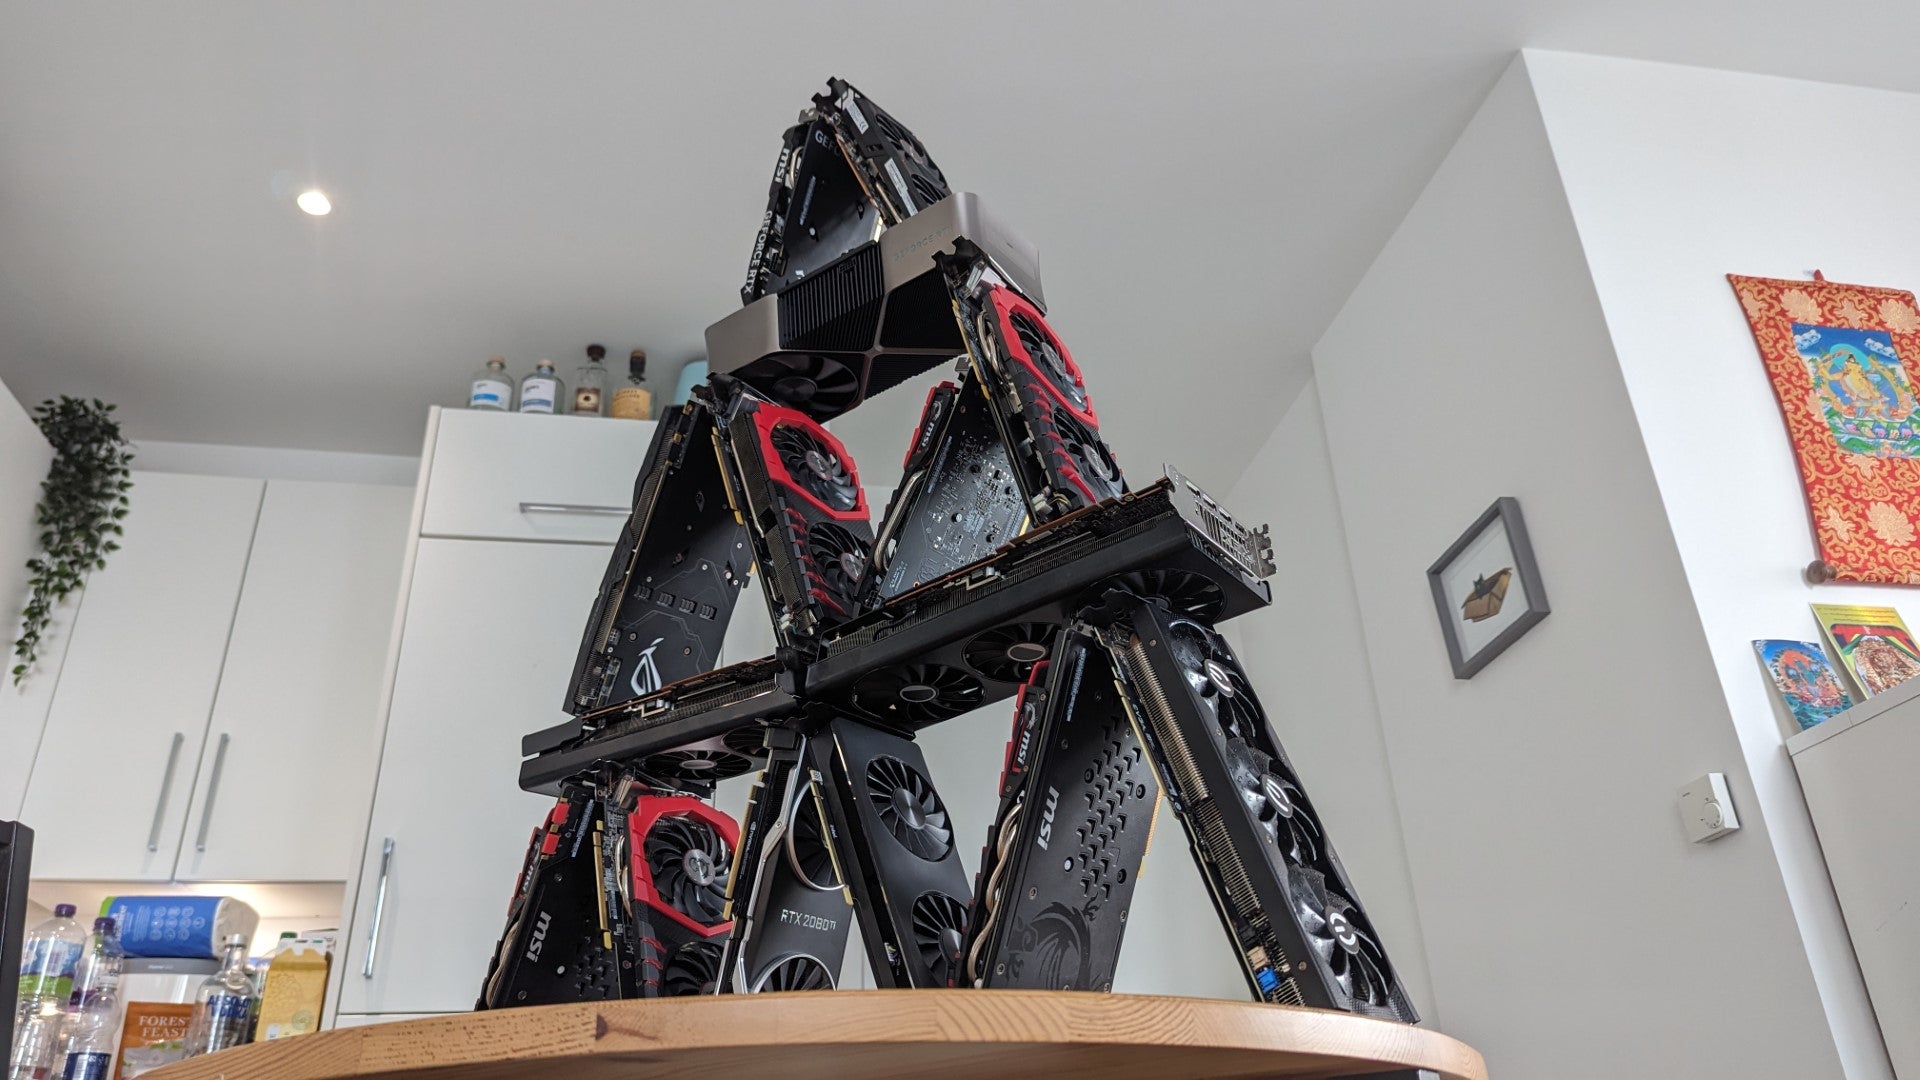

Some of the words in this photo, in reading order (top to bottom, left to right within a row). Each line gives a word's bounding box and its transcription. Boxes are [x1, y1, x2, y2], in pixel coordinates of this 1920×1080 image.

[750, 210, 773, 267] GEFORCE
[743, 269, 758, 294] RTX
[1017, 731, 1031, 765] msi
[1037, 785, 1060, 851] msi
[526, 911, 552, 963] msi
[780, 908, 802, 926] RTX
[802, 914, 829, 931] 2080
